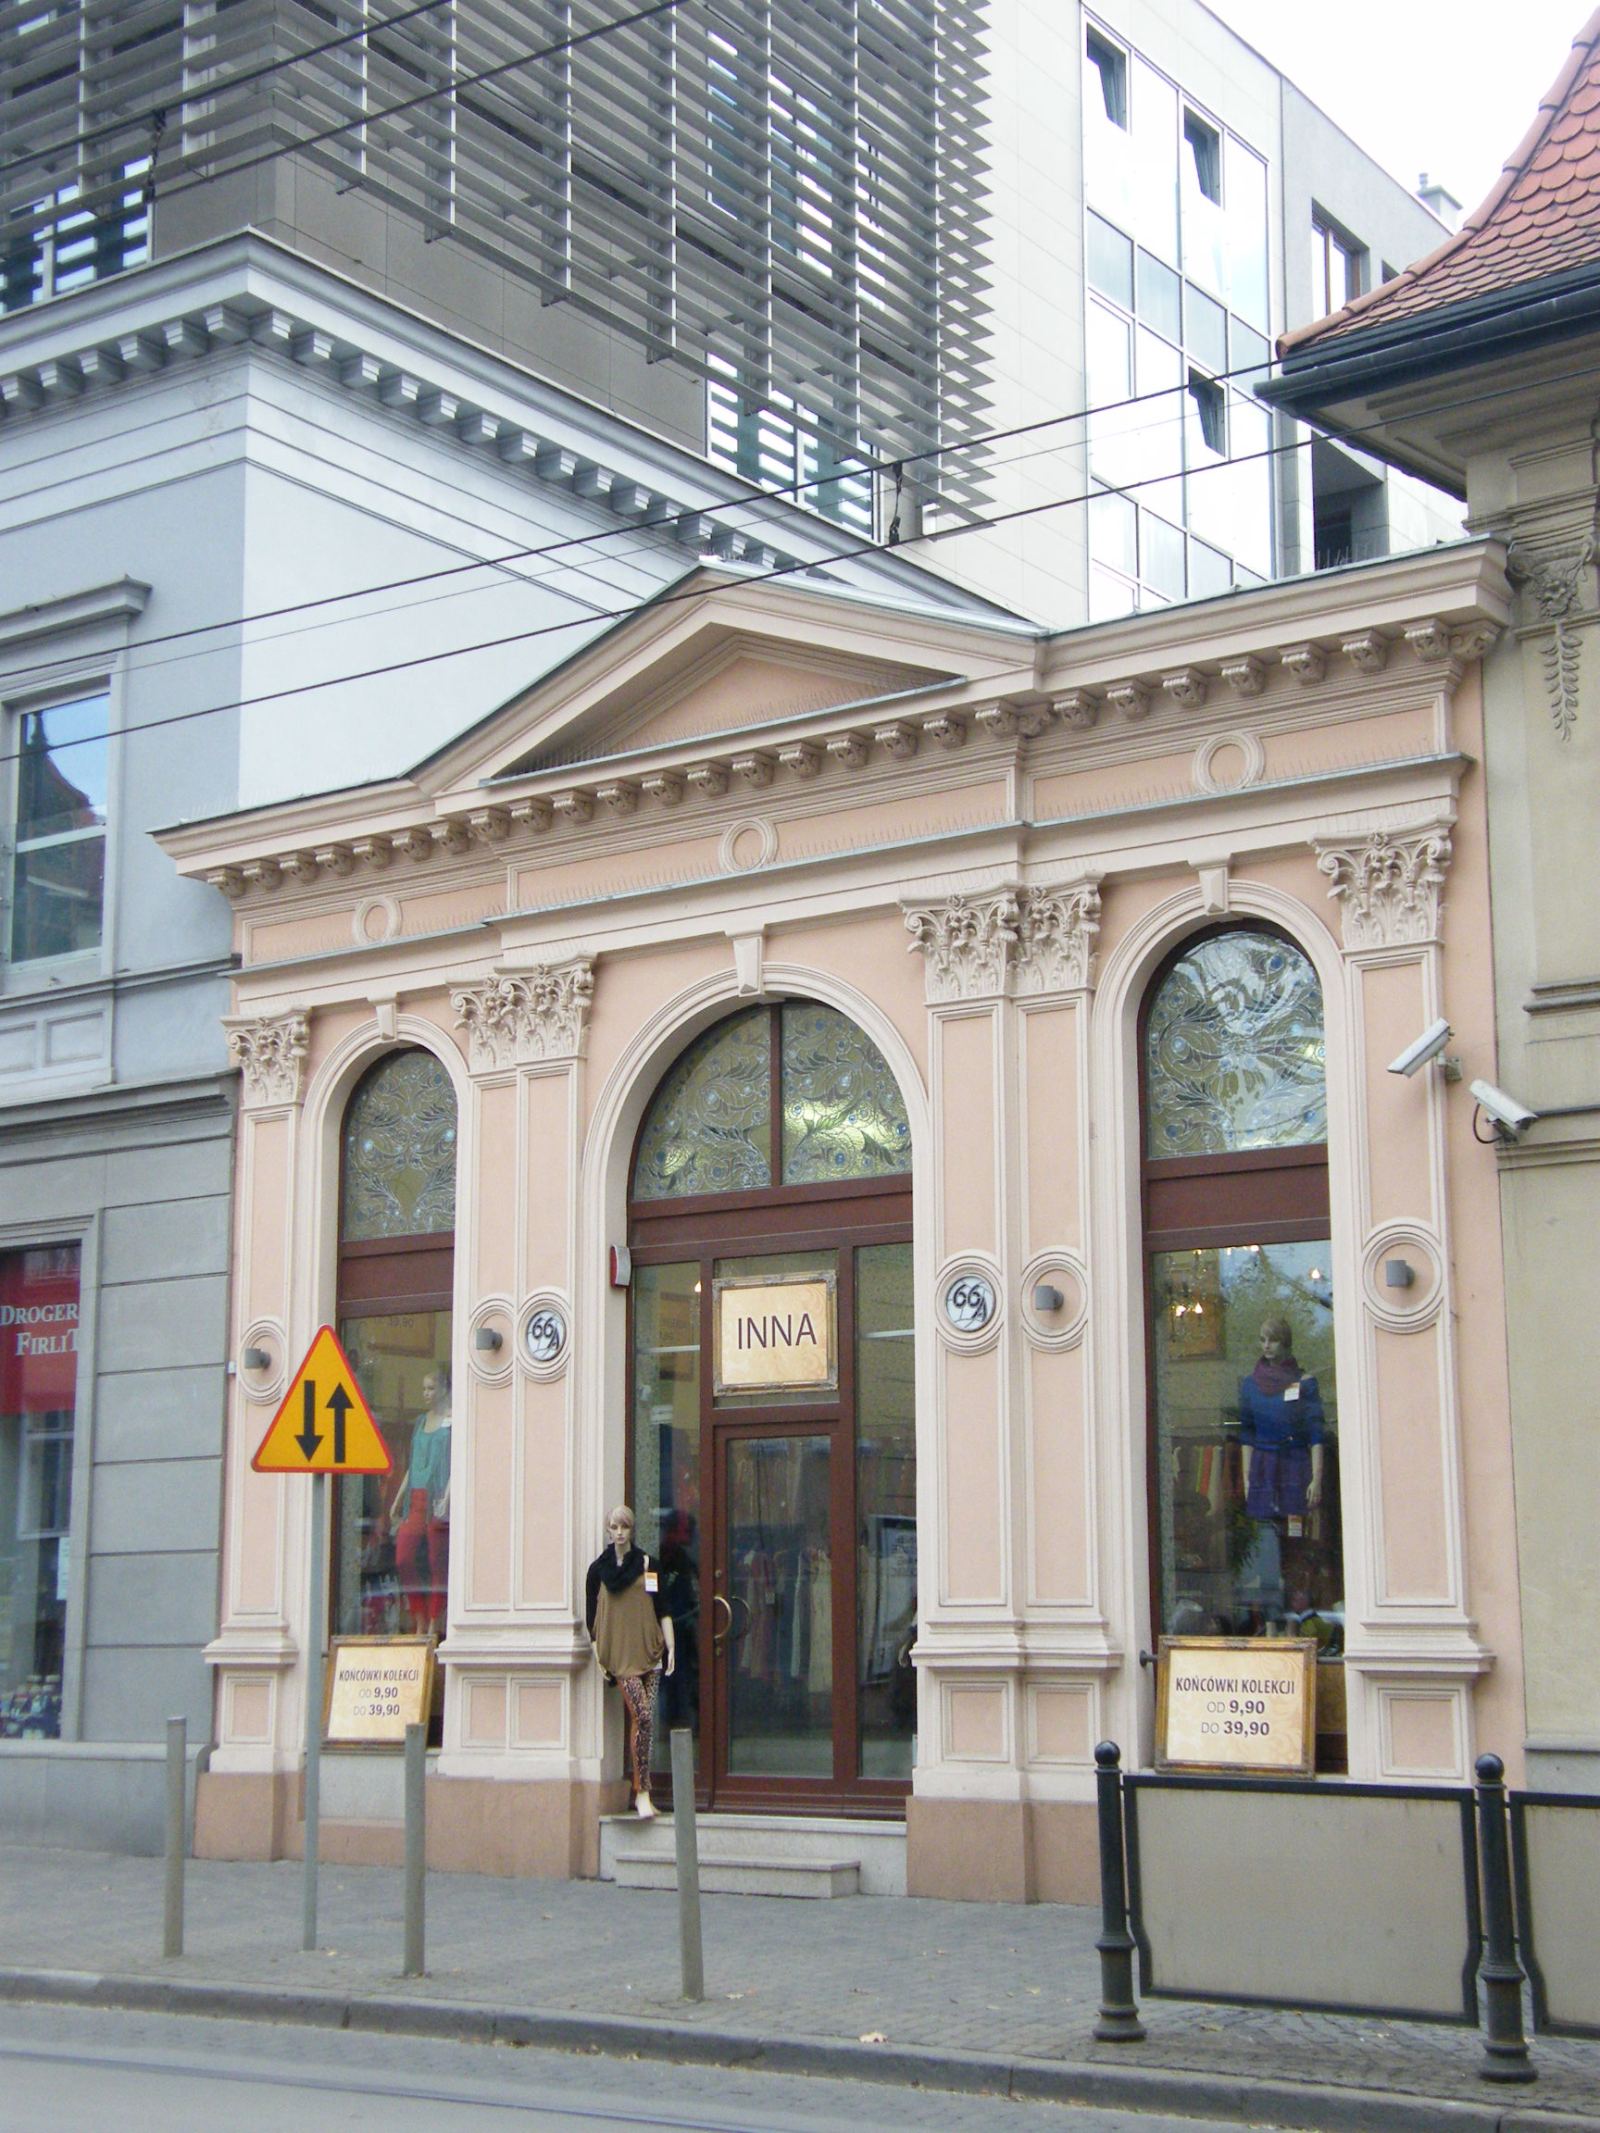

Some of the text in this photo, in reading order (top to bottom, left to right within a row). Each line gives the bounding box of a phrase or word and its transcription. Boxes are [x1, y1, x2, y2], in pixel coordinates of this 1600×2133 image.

[953, 1283, 988, 1322] 66A
[738, 1313, 817, 1350] INNA
[384, 1669, 420, 1682] KOLEKCJI
[374, 1686, 399, 1700] 9,90
[1175, 1675, 1295, 1695] KOŃCÓWKI KOLEKCJI
[368, 1703, 401, 1717] 39,90
[1206, 1699, 1265, 1717] OD 9,90
[1201, 1720, 1270, 1738] DO 39,90
